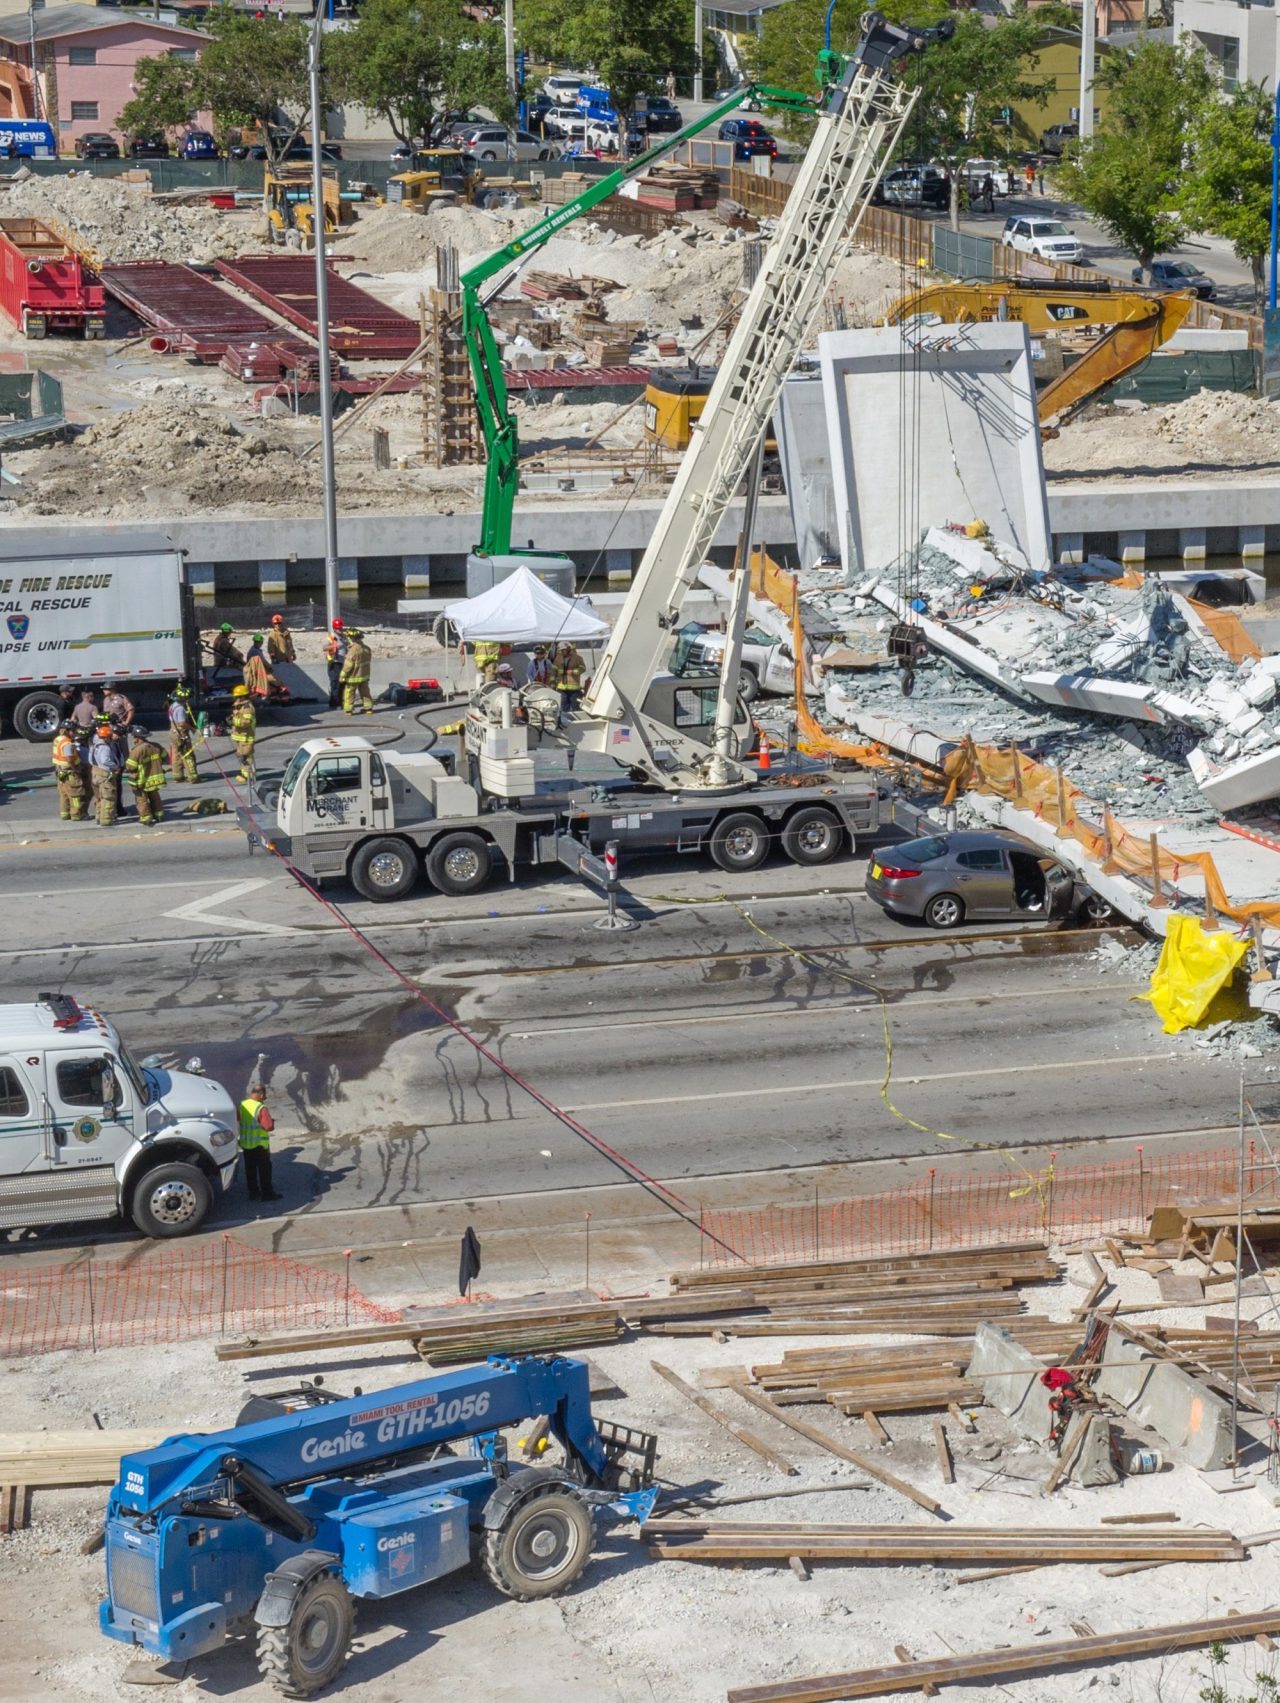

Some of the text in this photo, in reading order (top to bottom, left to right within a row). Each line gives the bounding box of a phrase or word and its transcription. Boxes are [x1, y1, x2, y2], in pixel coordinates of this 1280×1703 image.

[14, 132, 46, 140] NEWS
[521, 203, 582, 247] SUNBELT RENTALS
[1057, 307, 1075, 319] CAT
[19, 577, 52, 592] FIRE
[56, 574, 112, 590] RESCUE
[30, 597, 92, 611] RESCUE
[154, 631, 175, 640] 911
[38, 640, 70, 651] UNIT
[307, 796, 358, 812] MERCHANT
[317, 803, 350, 818] CRANE
[357, 1396, 436, 1422] MIAMI TOOL RENTAL
[301, 1391, 490, 1463] Genie GTH-1056
[127, 1471, 144, 1484] GTH
[124, 1481, 144, 1496] 1056
[124, 1531, 142, 1544] Genie
[377, 1532, 416, 1552] Genie
